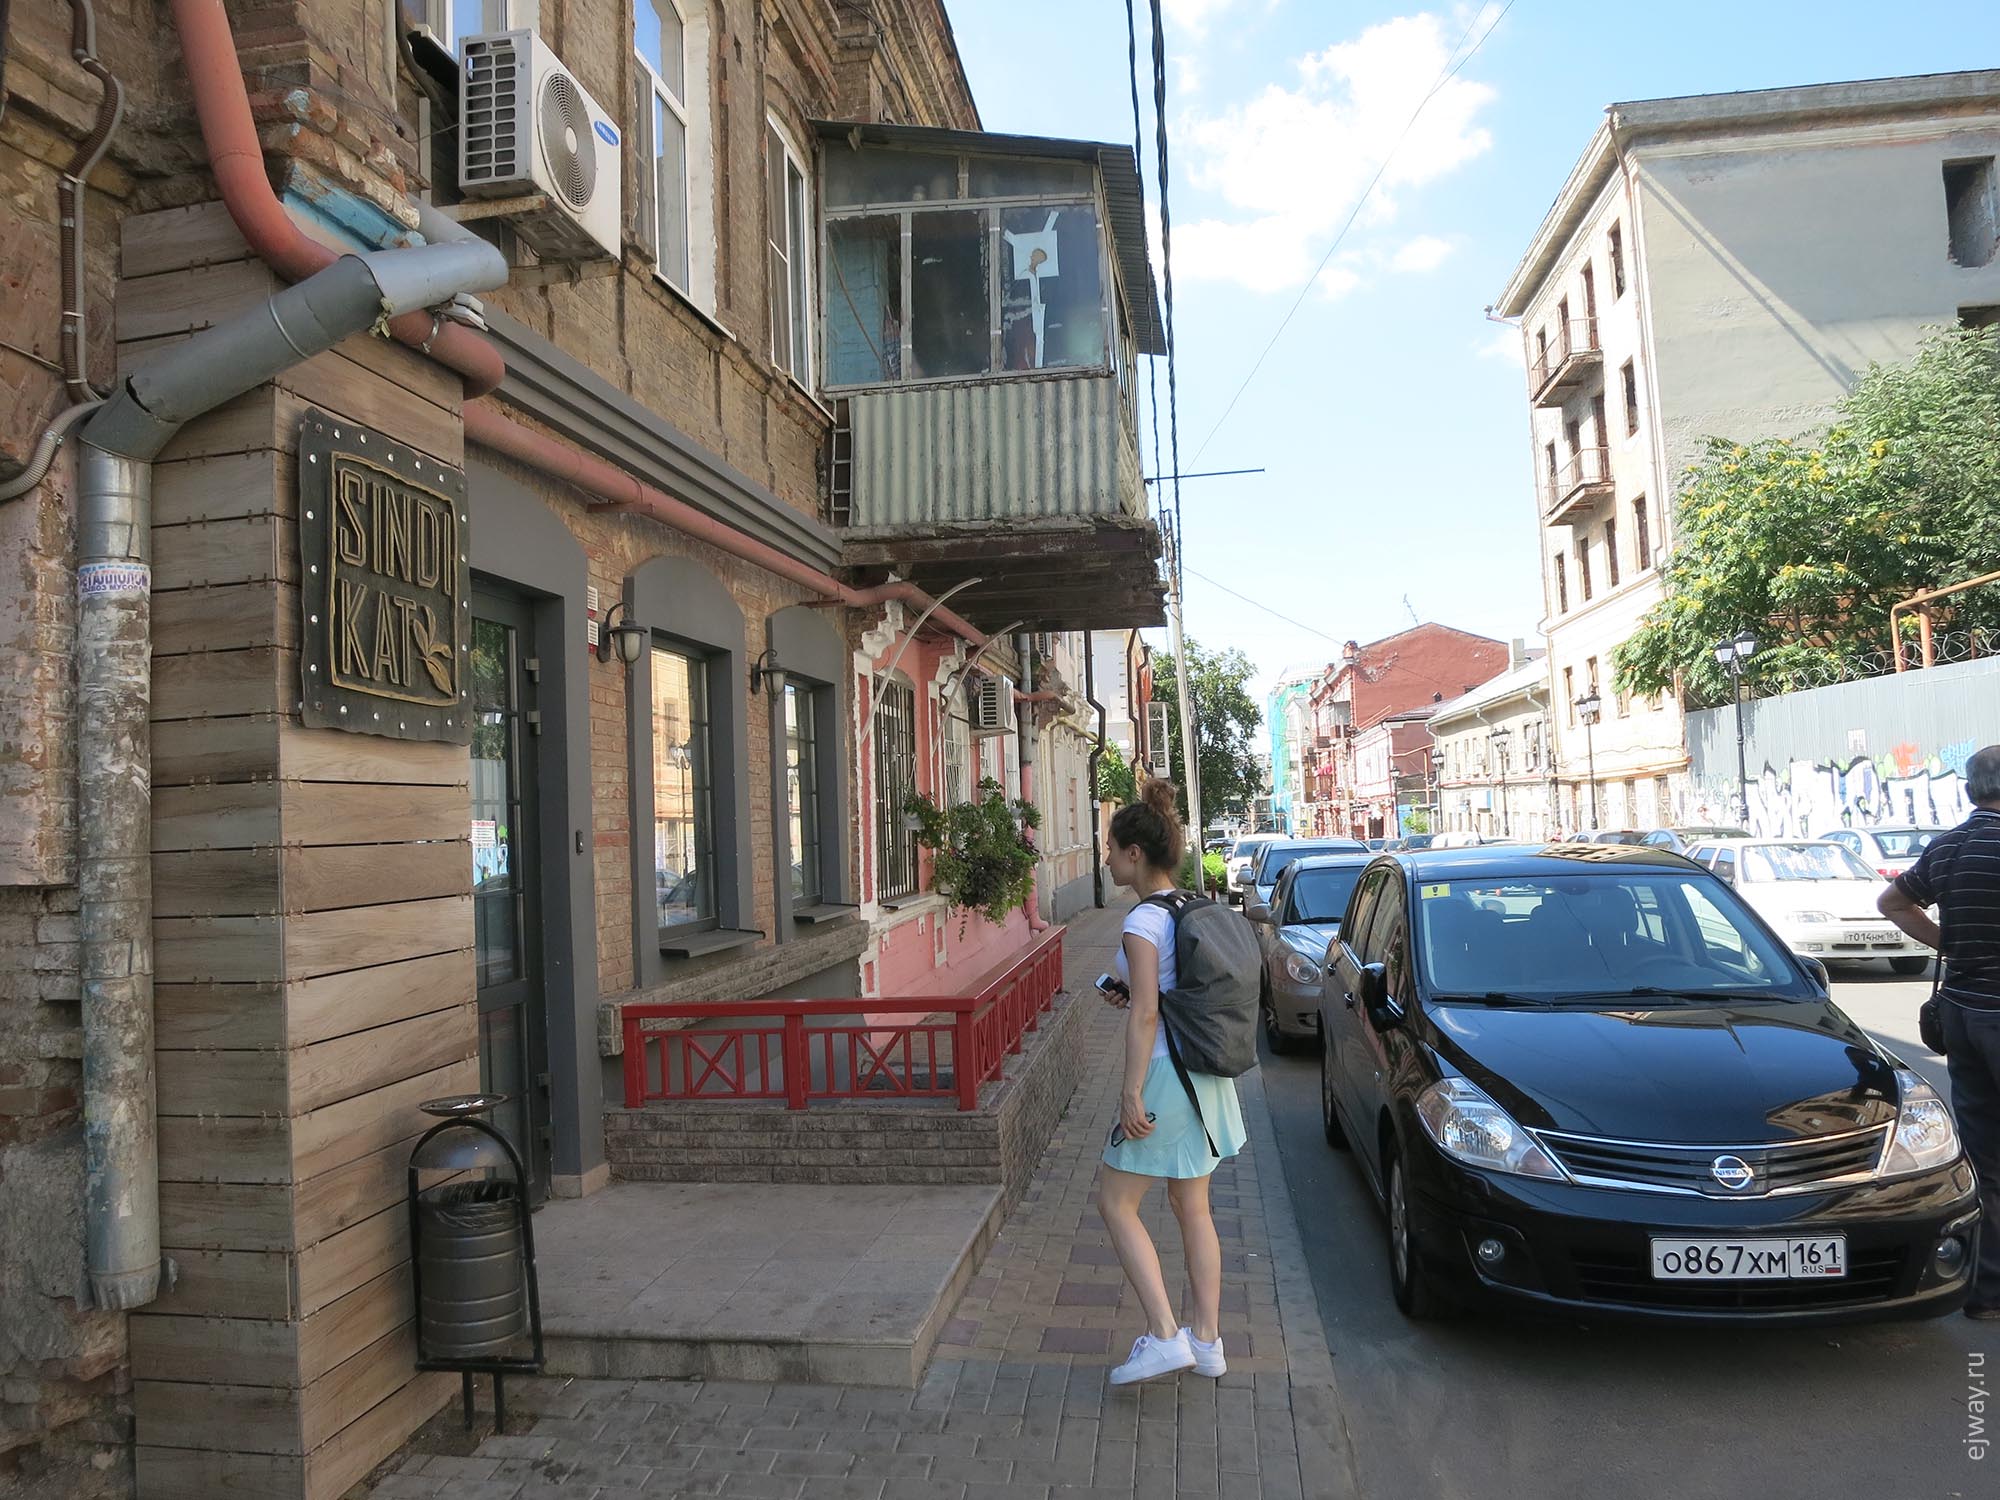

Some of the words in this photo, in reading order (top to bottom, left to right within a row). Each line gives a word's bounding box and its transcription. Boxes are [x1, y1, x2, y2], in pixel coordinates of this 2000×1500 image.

[340, 467, 451, 596] SINDI
[341, 578, 416, 687] KAT
[1793, 1241, 1837, 1264] 161
[1802, 1264, 1824, 1274] RUS
